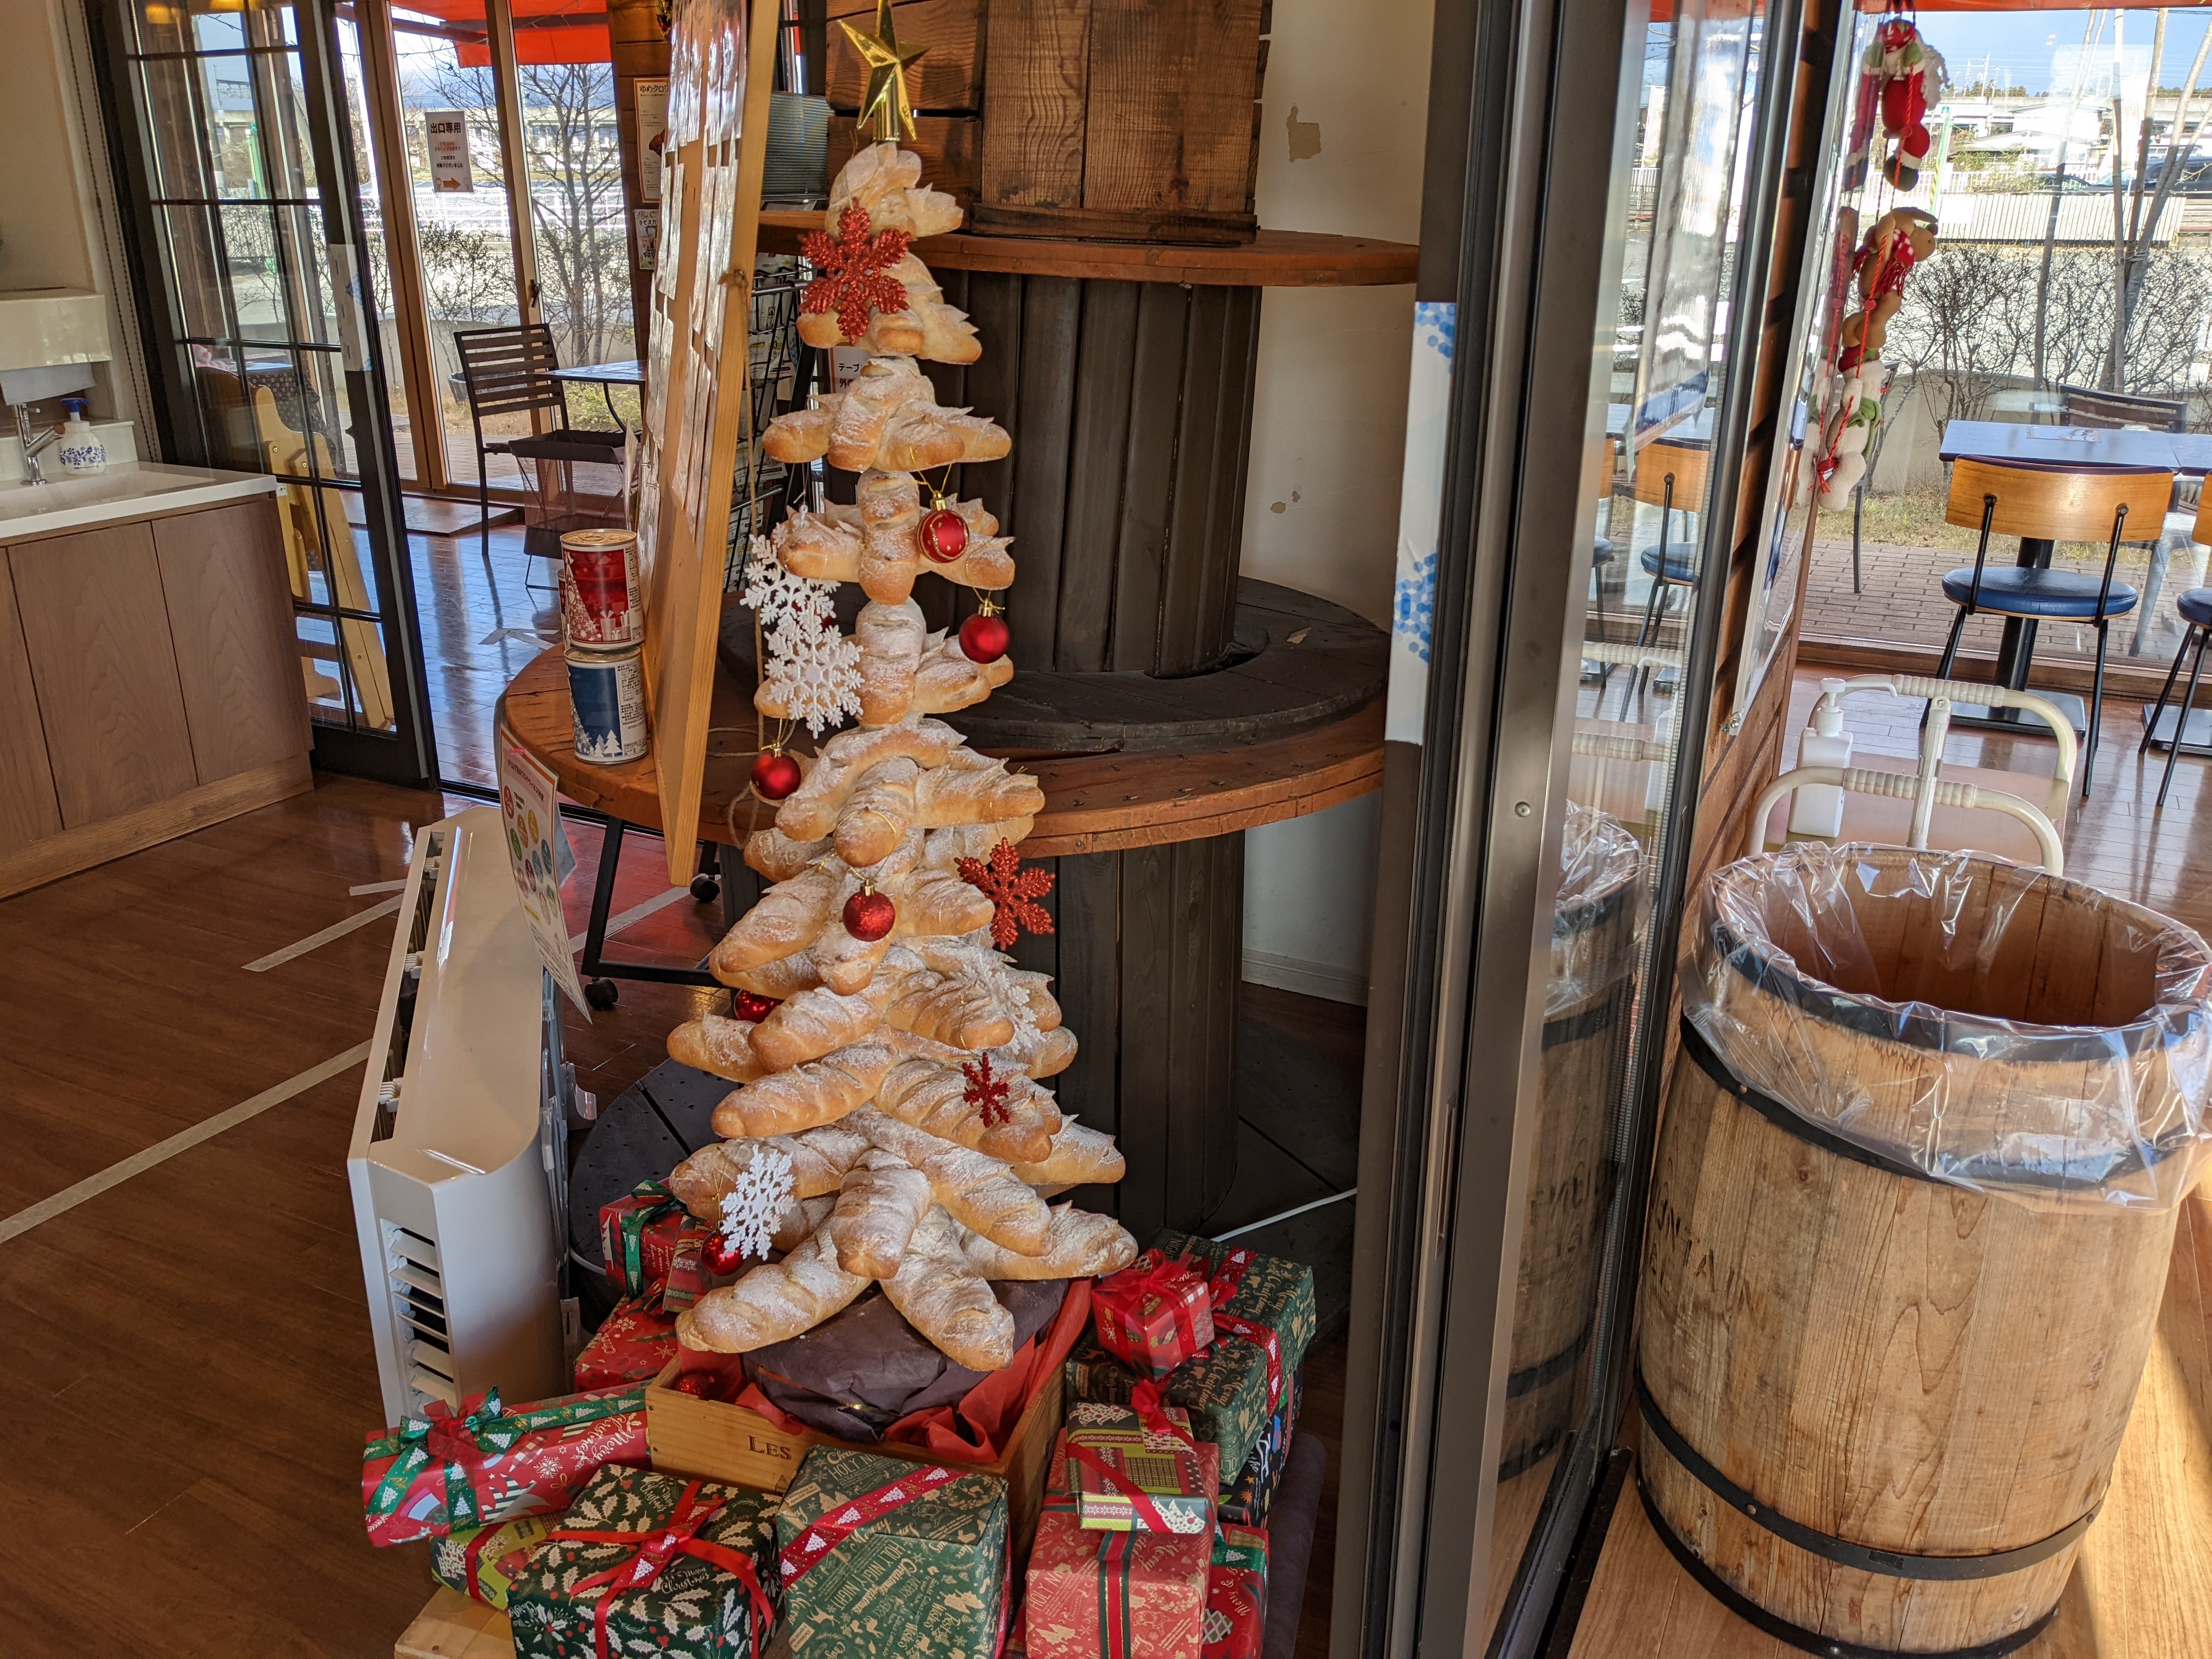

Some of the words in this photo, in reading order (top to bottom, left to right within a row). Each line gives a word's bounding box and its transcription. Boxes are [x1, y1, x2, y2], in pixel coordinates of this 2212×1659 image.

[430, 122, 461, 133] 出口専用
[1268, 1283, 1297, 1312] Merry
[1211, 1374, 1244, 1406] Merry
[575, 1413, 627, 1455] Christmas
[591, 1427, 635, 1461] Merry
[748, 1435, 792, 1459] LES
[827, 1458, 860, 1482] HOLY
[878, 1539, 906, 1568] HOLY
[1138, 1534, 1179, 1572] Merry
[661, 1572, 710, 1594] Christmas
[1028, 1582, 1054, 1611] HOLY
